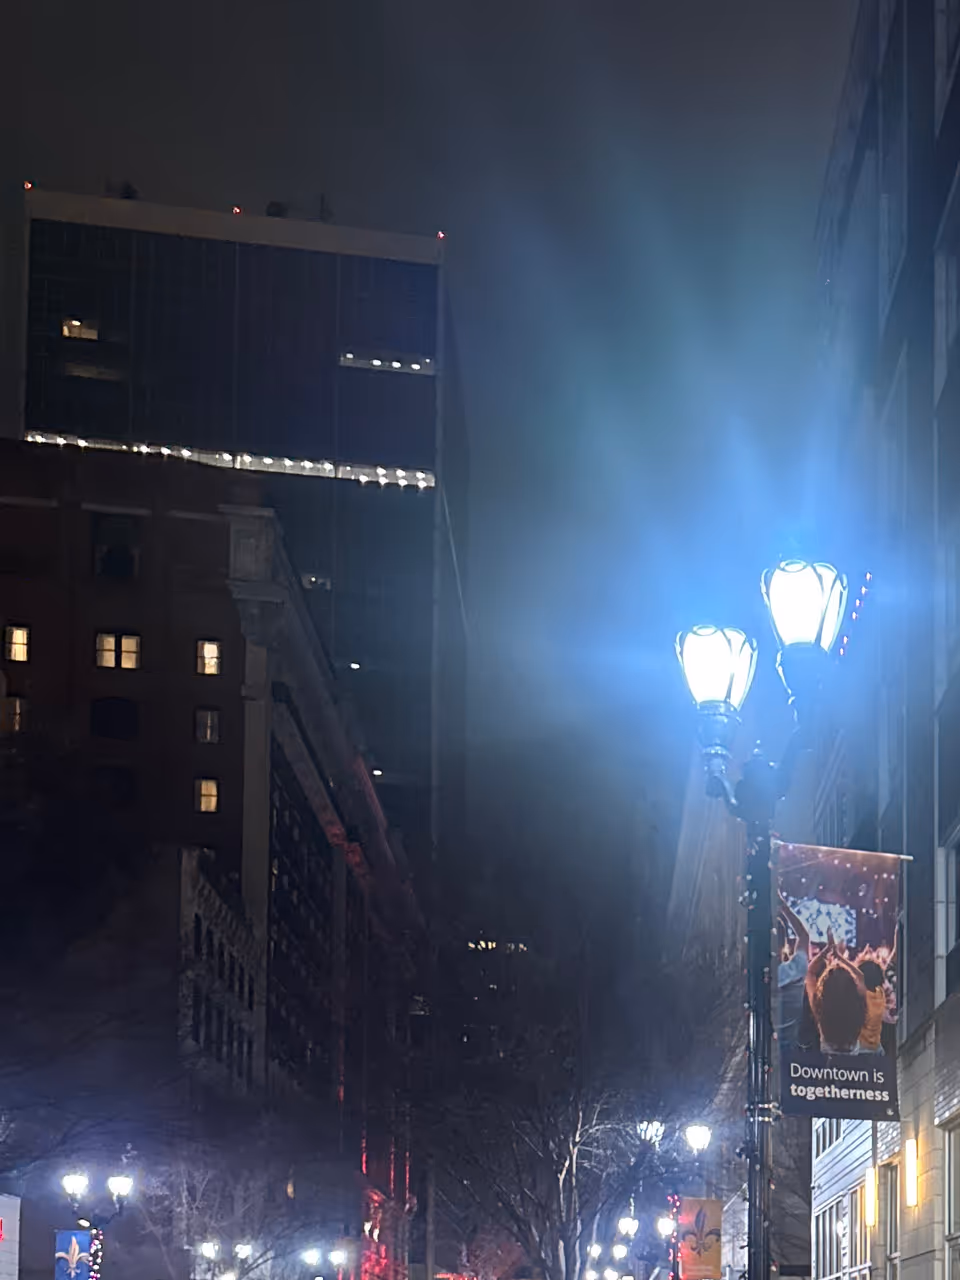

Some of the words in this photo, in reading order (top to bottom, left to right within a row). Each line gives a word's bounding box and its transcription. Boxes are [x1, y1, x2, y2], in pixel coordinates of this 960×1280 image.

[790, 1062, 870, 1082] Downtown
[873, 1068, 885, 1083] is
[790, 1083, 890, 1102] togetherness
